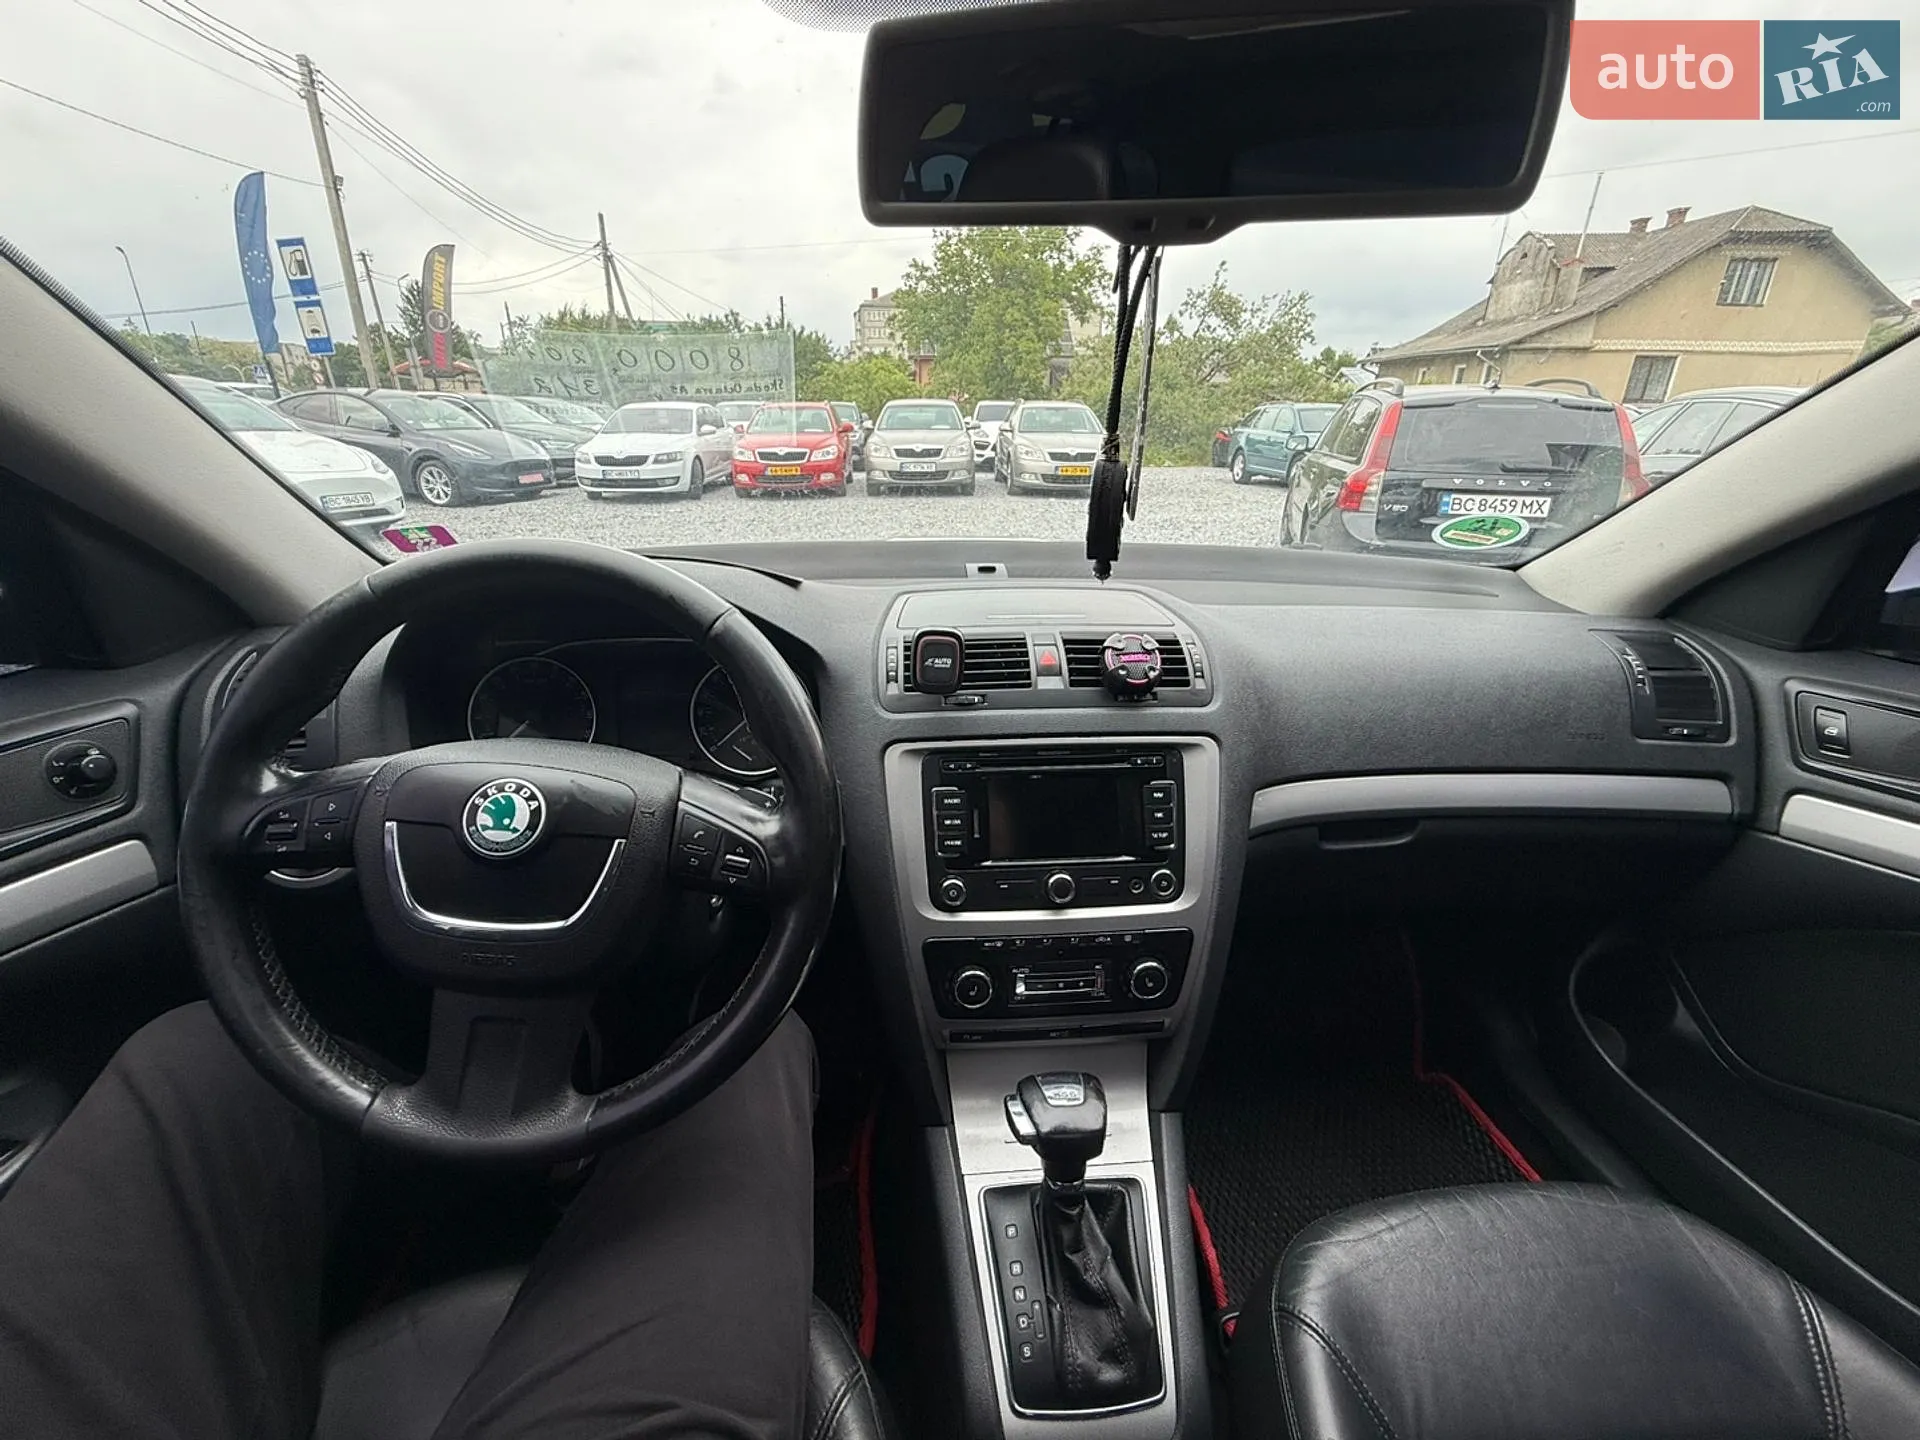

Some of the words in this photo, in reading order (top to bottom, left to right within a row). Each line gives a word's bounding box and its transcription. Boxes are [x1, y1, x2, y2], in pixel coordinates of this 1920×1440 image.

[432, 251, 446, 310] IMPORT
[1452, 478, 1552, 488] VOLVO
[1450, 497, 1475, 512] BC
[1477, 498, 1519, 513] 8459
[1519, 500, 1547, 515] MX
[1023, 1346, 1031, 1357] S
